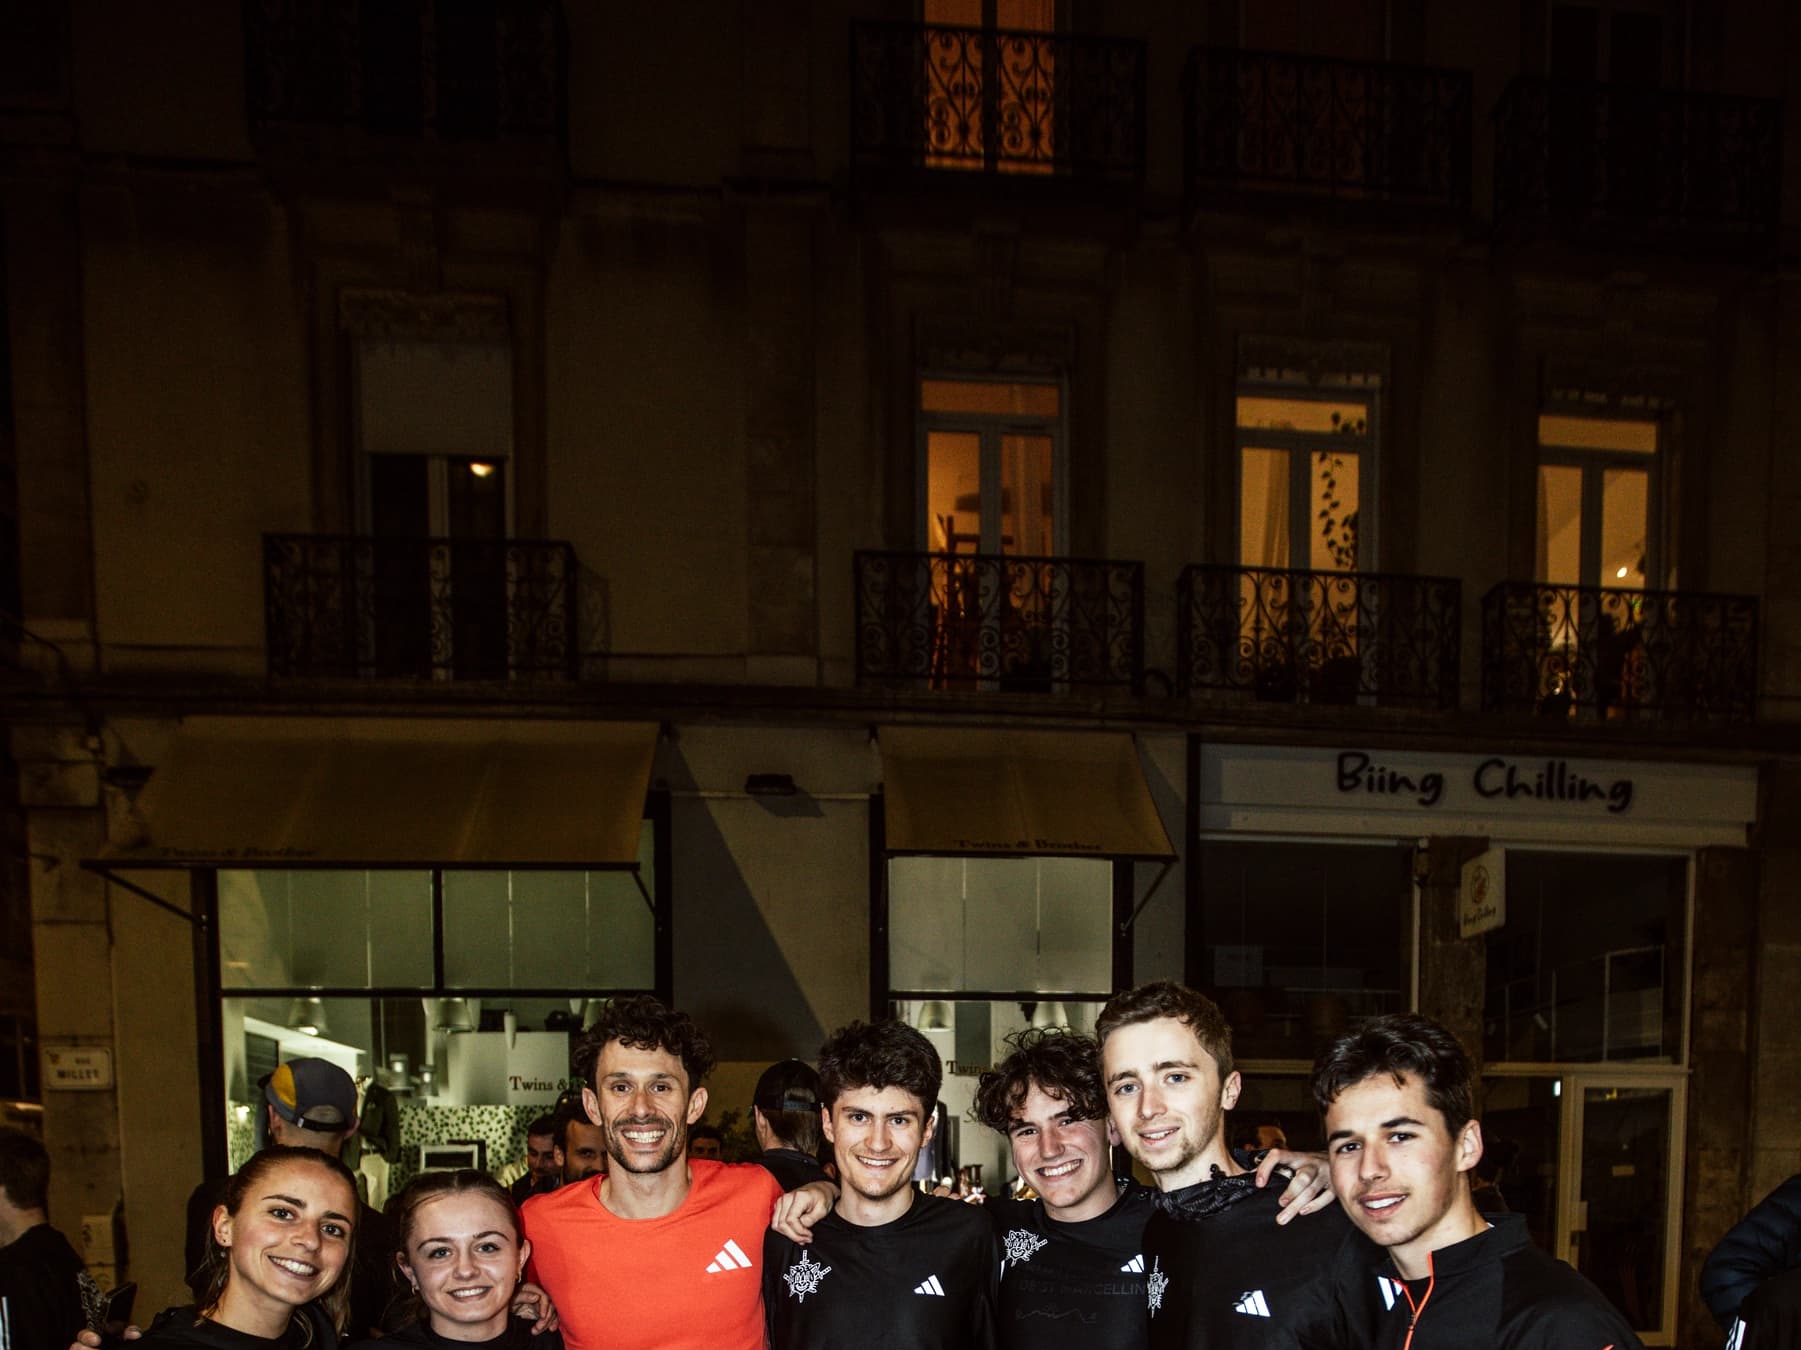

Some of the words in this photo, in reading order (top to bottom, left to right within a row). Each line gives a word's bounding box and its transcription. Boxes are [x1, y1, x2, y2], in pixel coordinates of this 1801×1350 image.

[1337, 751, 1443, 806] Biing
[1473, 757, 1633, 813] Chilling
[508, 1075, 553, 1091] Twins
[556, 1078, 568, 1090] &
